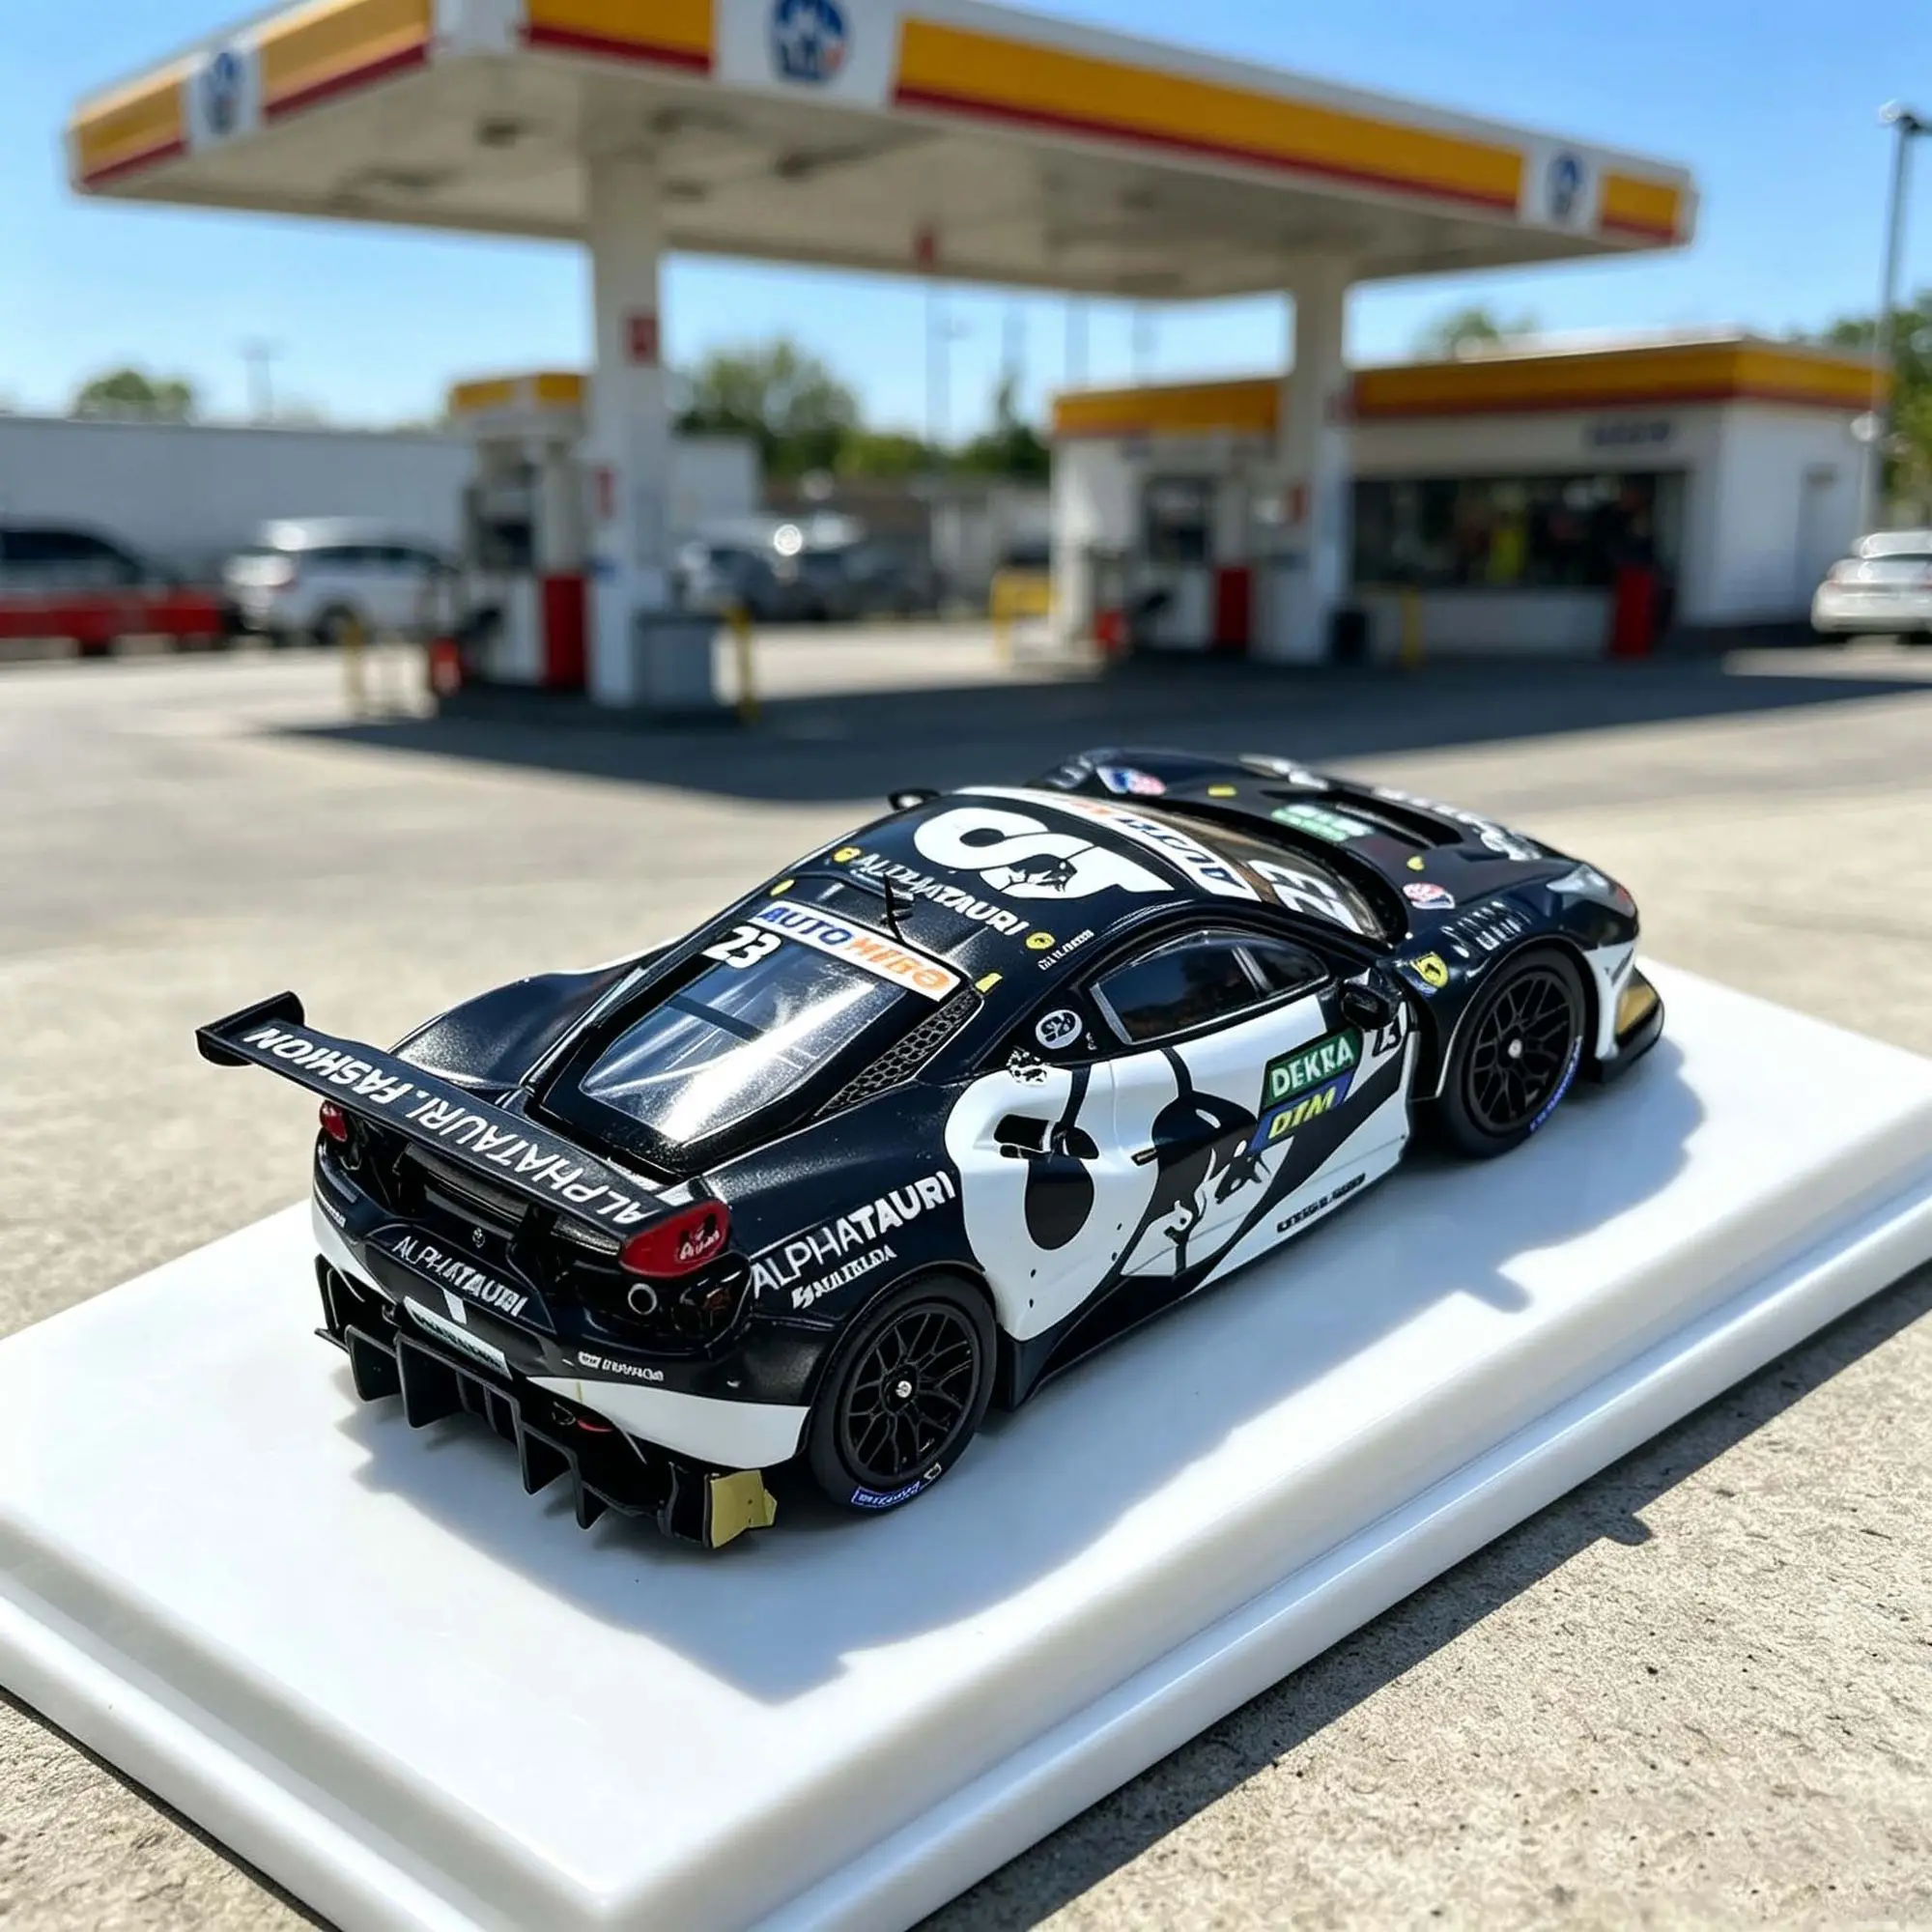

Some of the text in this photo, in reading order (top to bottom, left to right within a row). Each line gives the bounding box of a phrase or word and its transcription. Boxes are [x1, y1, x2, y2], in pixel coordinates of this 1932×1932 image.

[701, 925, 782, 969] 23
[1271, 1036, 1354, 1097] DEKRA
[1267, 1086, 1337, 1139] DTM
[751, 1171, 956, 1299] ALPHATAURI
[391, 1235, 528, 1317] ALPHATAURI
